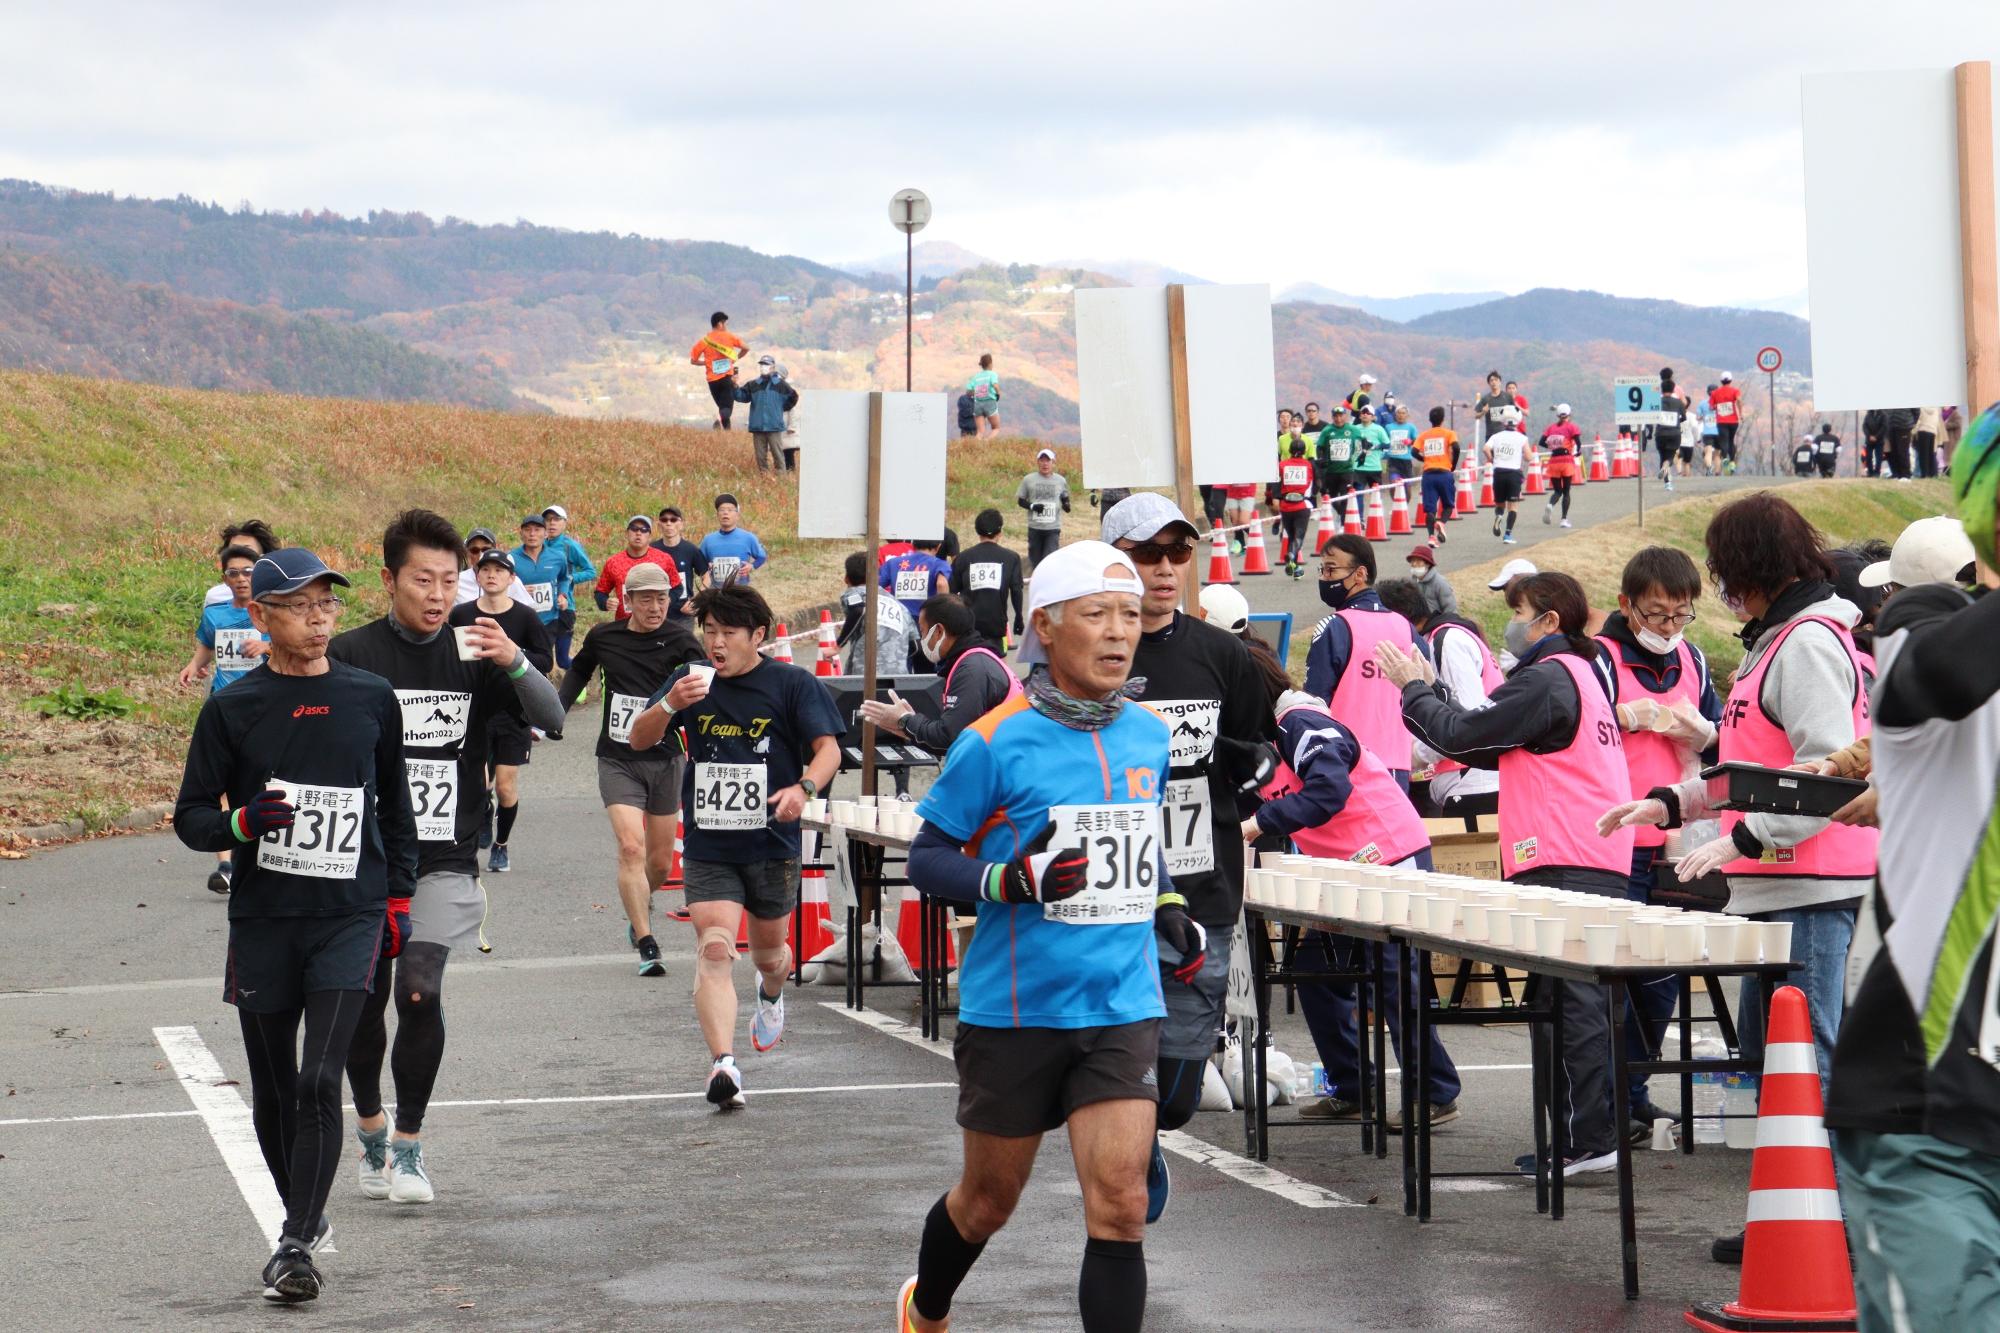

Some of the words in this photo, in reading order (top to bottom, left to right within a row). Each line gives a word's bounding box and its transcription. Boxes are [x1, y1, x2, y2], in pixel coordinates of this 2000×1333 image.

[1762, 353, 1777, 365] 40
[1628, 386, 1643, 411] 9
[400, 692, 470, 706] umagawa
[435, 730, 453, 738] 2022
[706, 767, 752, 779] 長野電子
[696, 780, 761, 811] B428
[1074, 810, 1146, 831] 長野電子
[261, 852, 355, 874] 第8回千曲川ハーフマラソン
